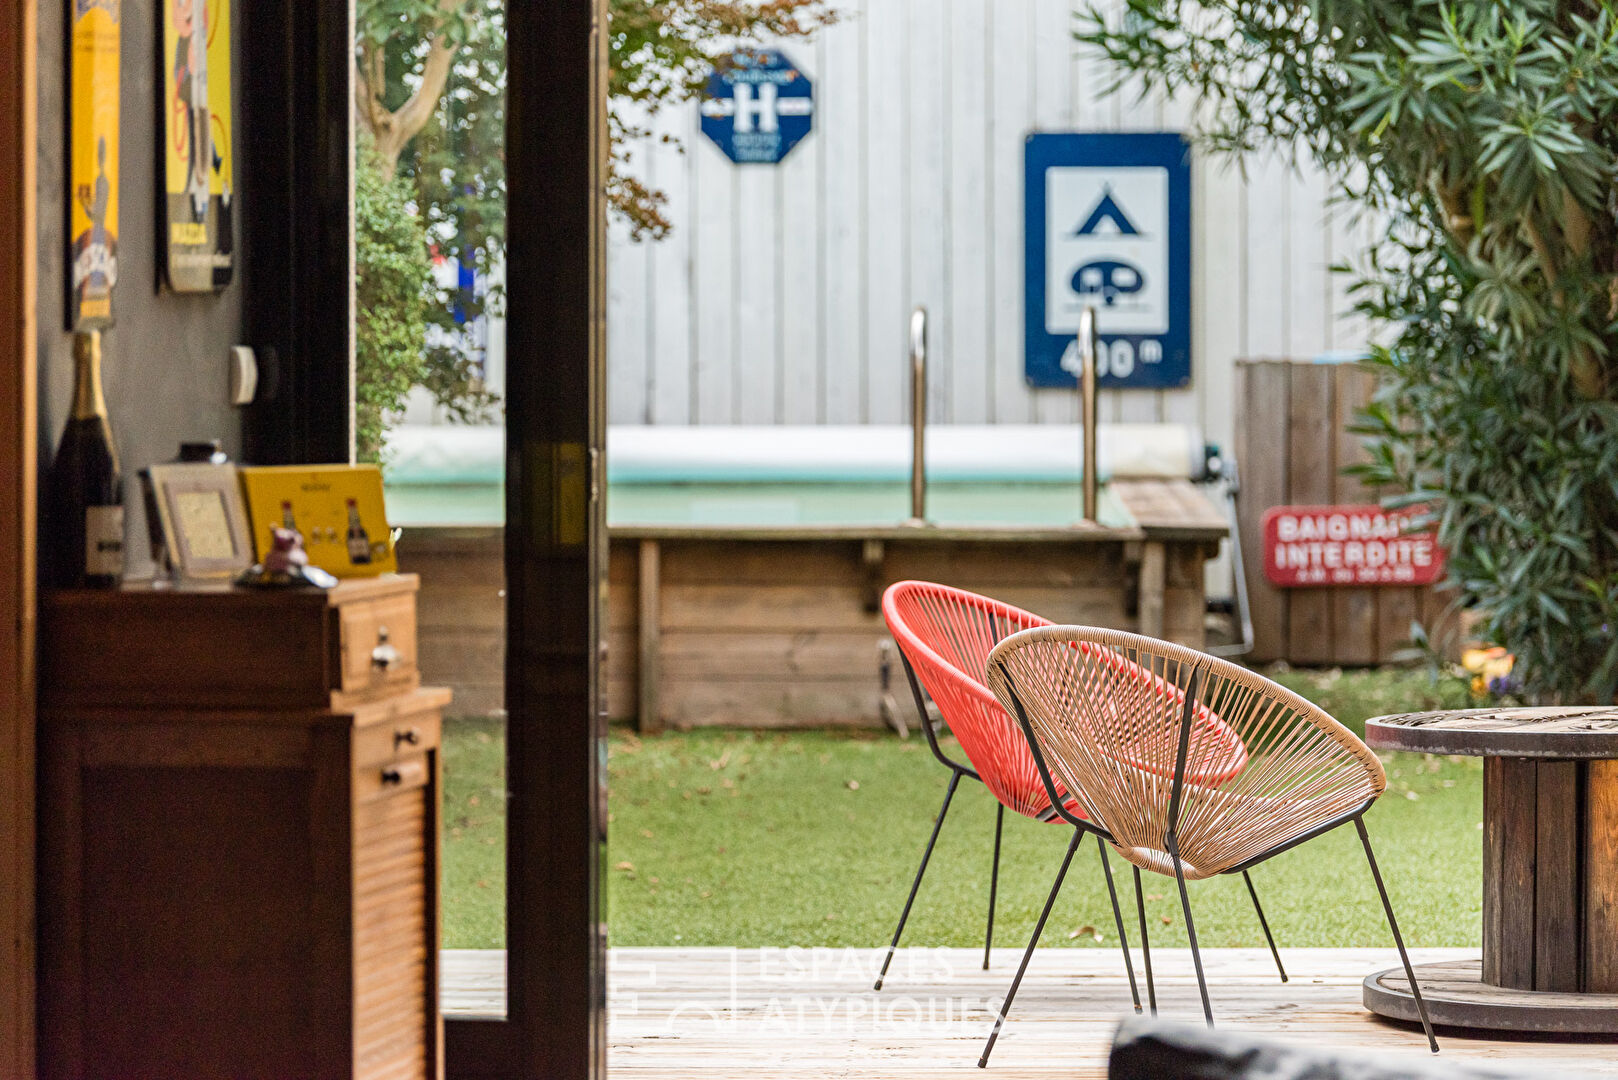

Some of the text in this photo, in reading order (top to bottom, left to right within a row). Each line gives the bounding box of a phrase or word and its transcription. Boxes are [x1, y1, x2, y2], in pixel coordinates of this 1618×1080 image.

[733, 82, 778, 132] H
[1060, 339, 1162, 378] 400 m
[1275, 540, 1433, 569] INTERDITE
